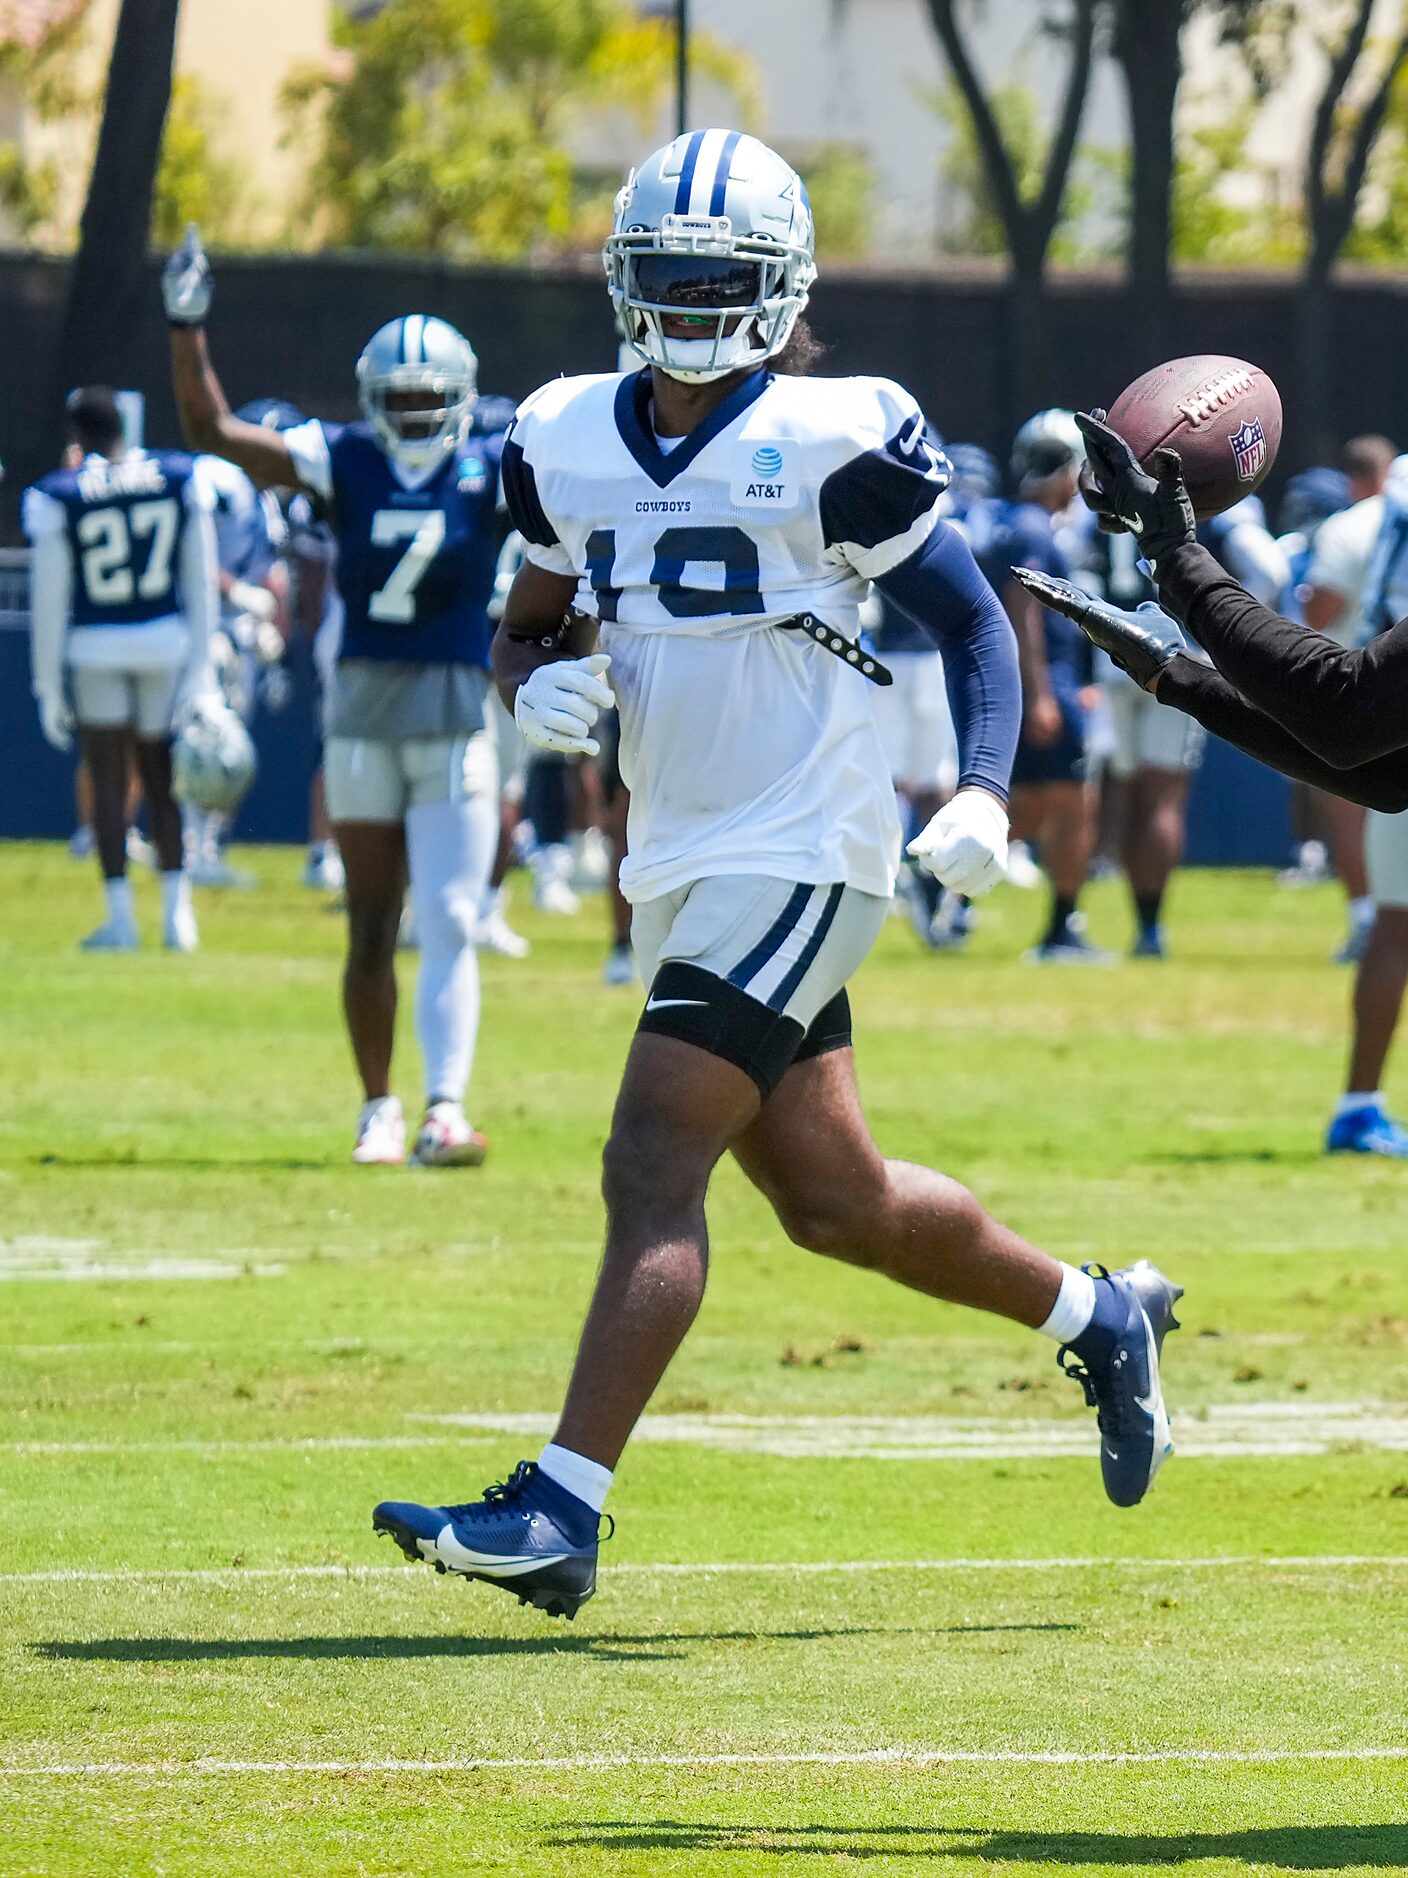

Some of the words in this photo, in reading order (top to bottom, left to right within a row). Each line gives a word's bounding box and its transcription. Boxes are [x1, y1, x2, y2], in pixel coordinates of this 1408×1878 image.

[1239, 443, 1264, 476] NFL
[635, 501, 691, 513] COWBOYS
[746, 484, 785, 499] AT&T
[77, 499, 178, 605] 27
[368, 509, 446, 624] 7
